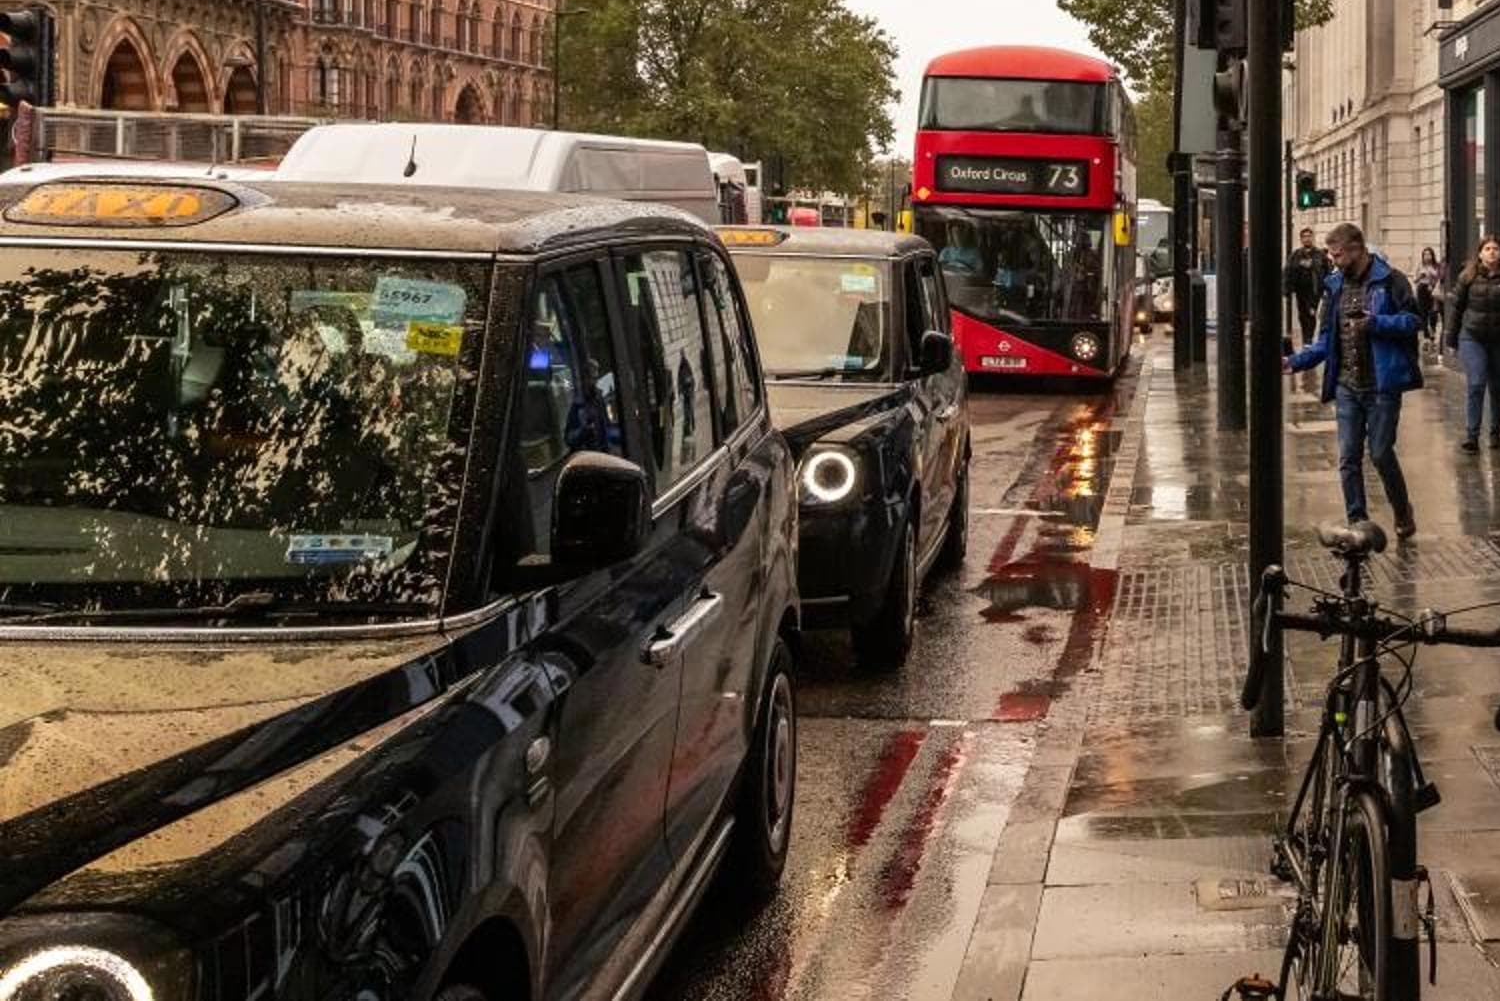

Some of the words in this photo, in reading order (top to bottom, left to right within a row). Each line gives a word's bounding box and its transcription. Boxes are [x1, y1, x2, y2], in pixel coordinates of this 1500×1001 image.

[950, 165, 990, 180] Oxford
[993, 167, 1027, 183] Circus
[1047, 165, 1080, 188] 73
[30, 187, 198, 220] TAXI
